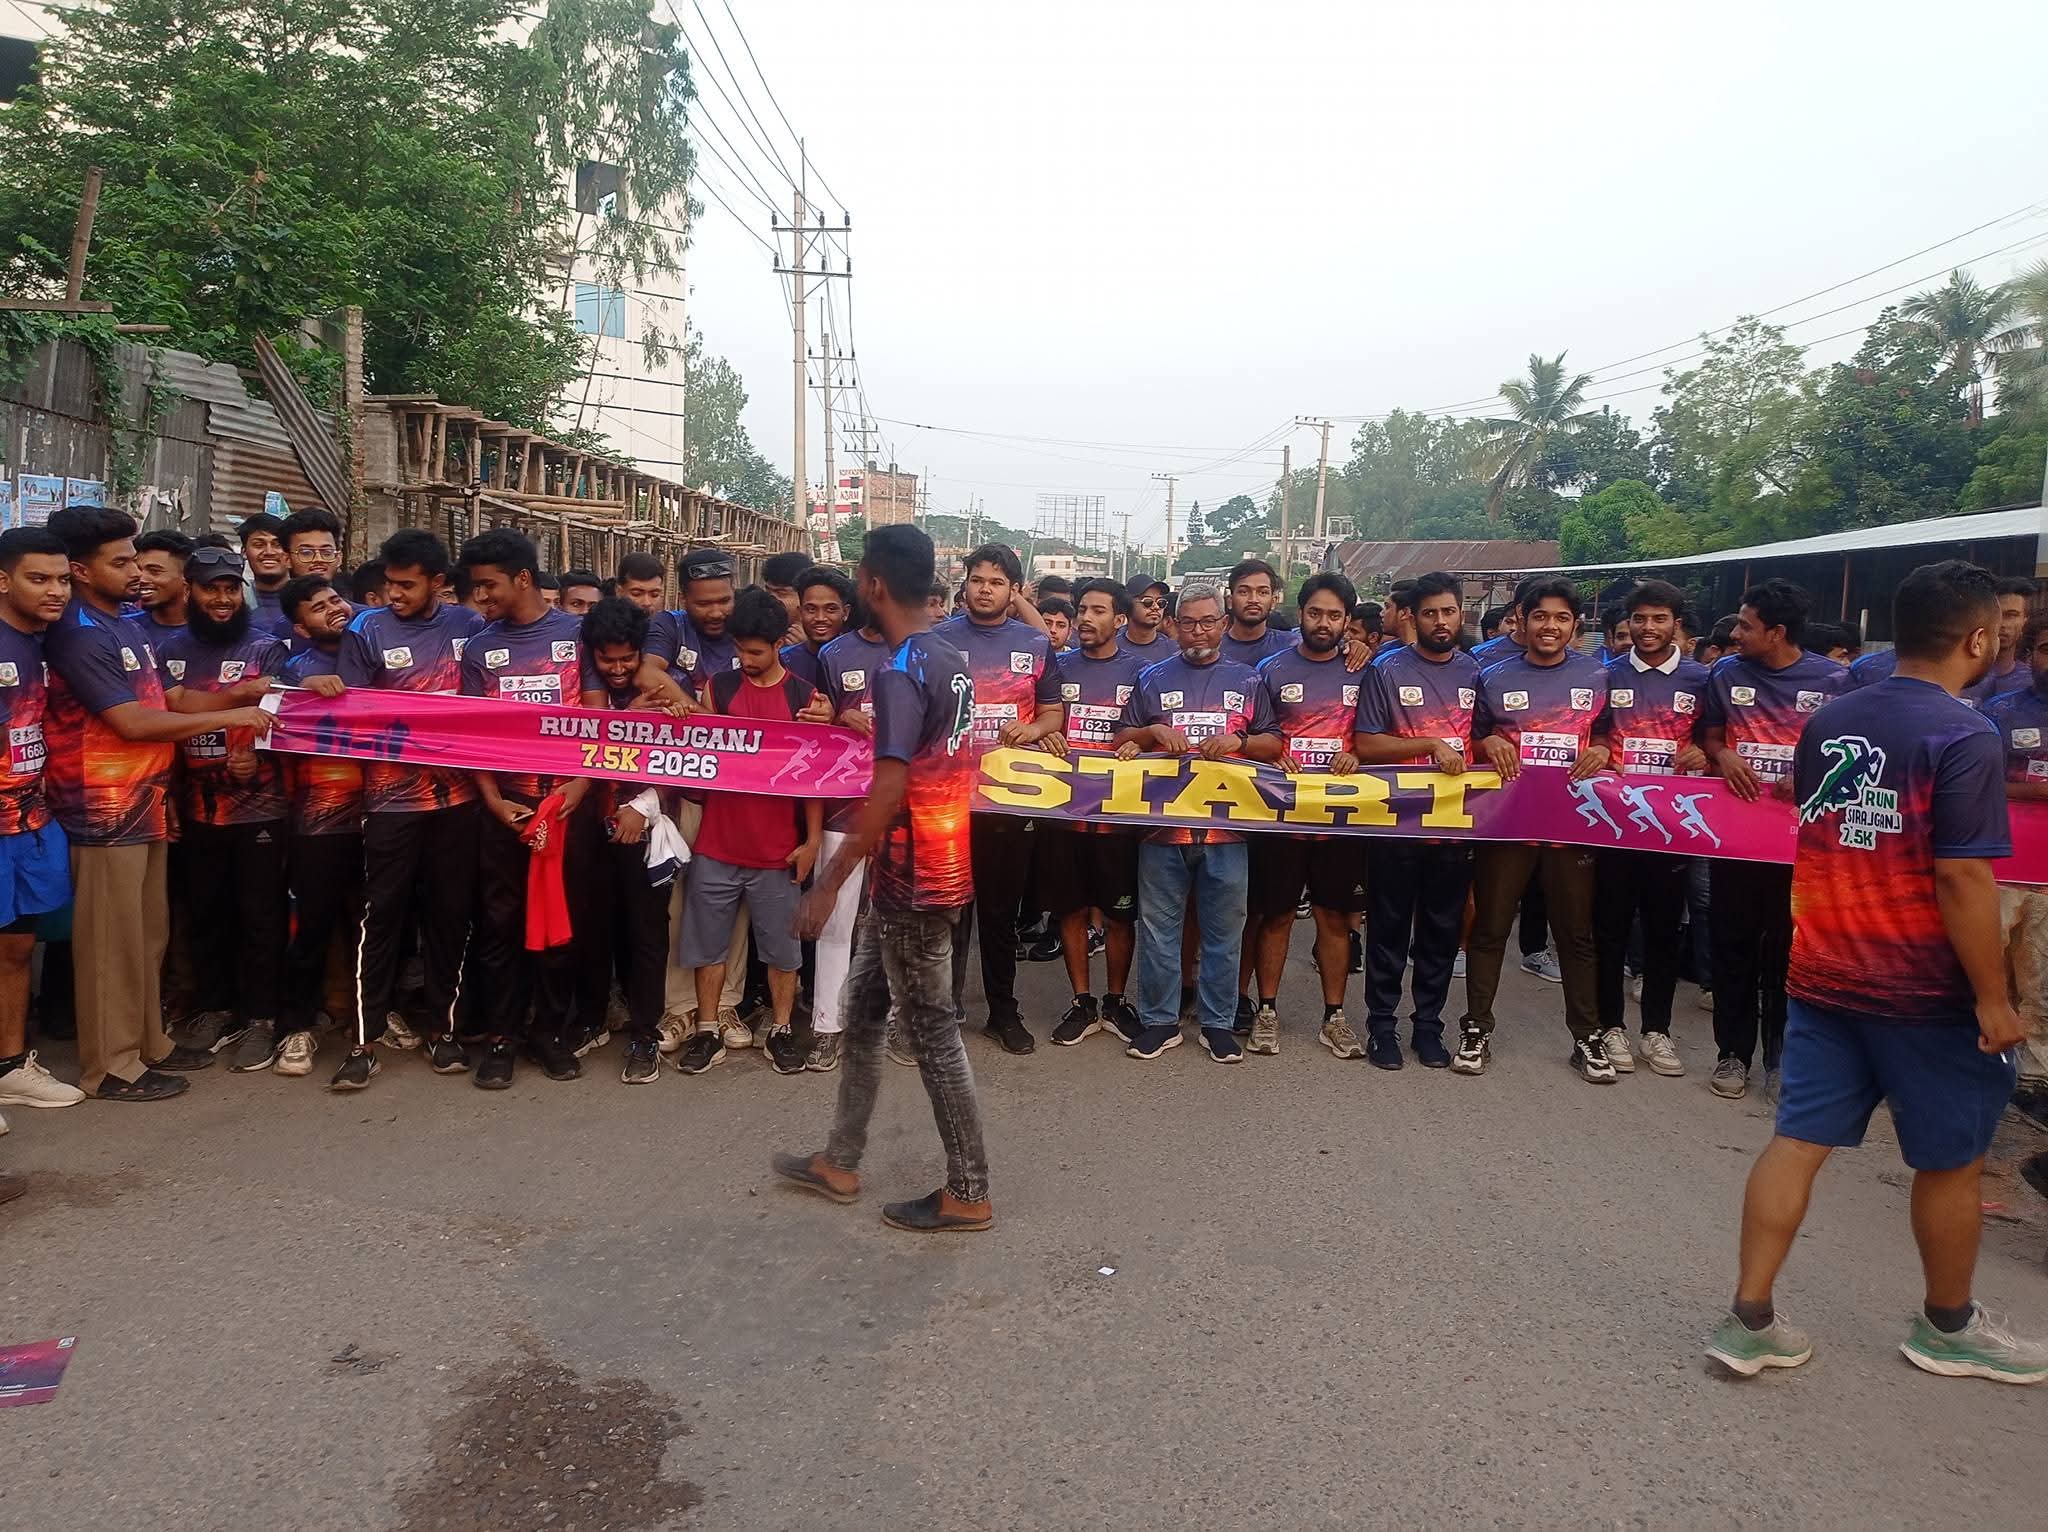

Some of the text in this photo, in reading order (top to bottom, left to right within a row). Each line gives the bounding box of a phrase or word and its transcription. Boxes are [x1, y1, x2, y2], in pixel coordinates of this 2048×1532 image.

[511, 691, 552, 703] 1305
[1078, 719, 1111, 731] 1623
[1183, 725, 1216, 736] 1611
[539, 716, 762, 753] RUN SIRAJGANJ
[580, 743, 718, 779] 7.5K 2026
[1300, 752, 1334, 764] 1197
[1530, 747, 1568, 760] 1706
[1632, 752, 1669, 766] 1337
[978, 746, 1502, 828] START
[1865, 790, 1895, 809] RUN
[1847, 808, 1901, 830] SIRAJGANJ
[1843, 827, 1873, 847] 7.5K
